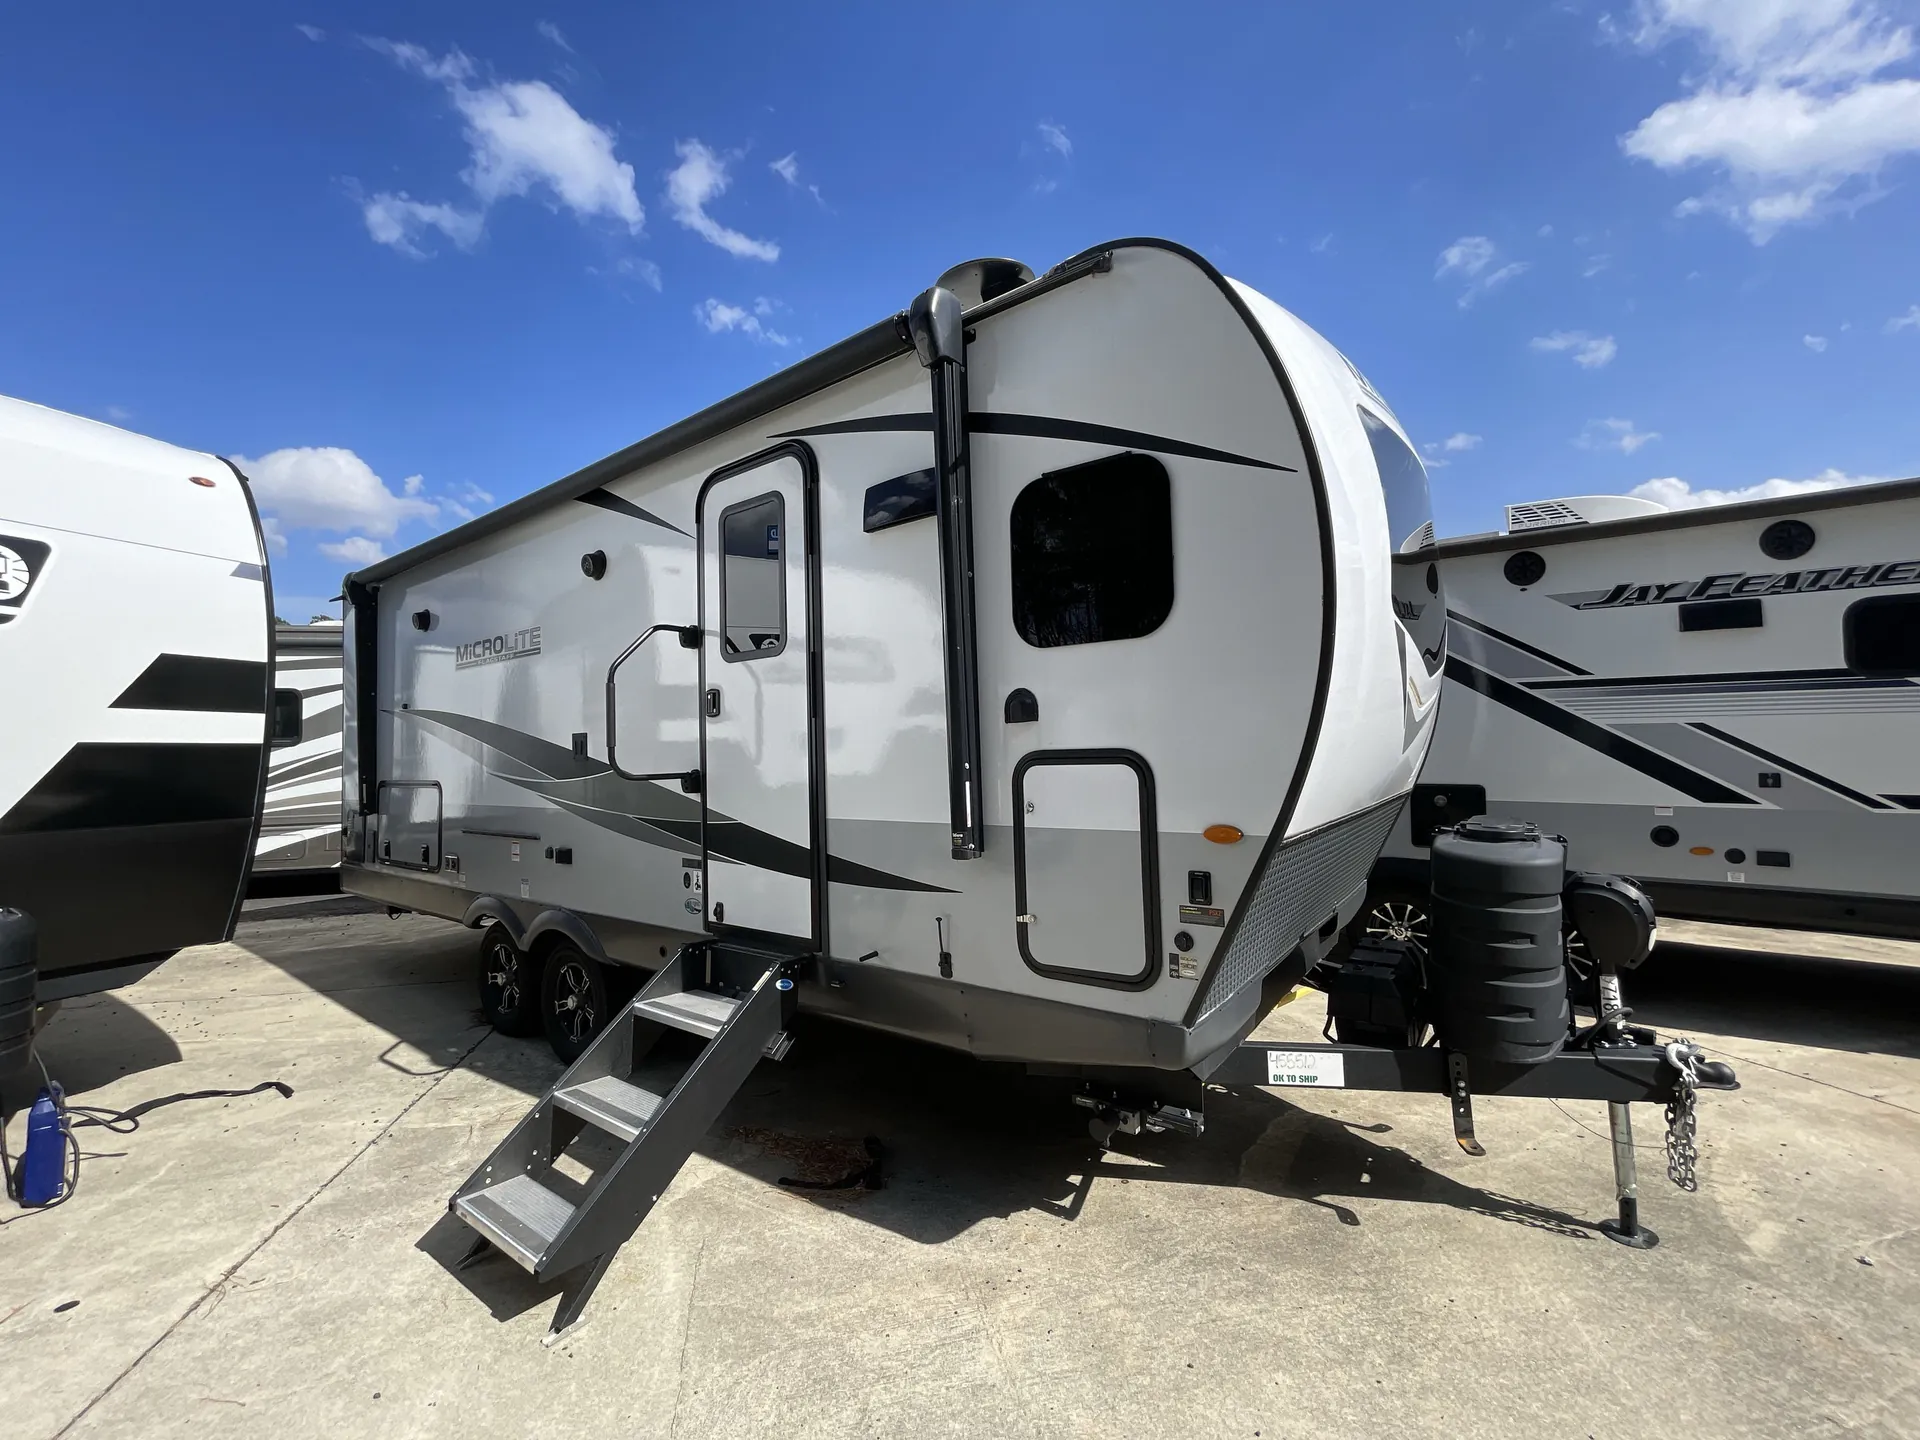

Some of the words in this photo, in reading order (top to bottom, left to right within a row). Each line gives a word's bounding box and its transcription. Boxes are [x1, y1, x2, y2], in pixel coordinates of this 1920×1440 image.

[1579, 582, 1683, 609] JAY
[1686, 560, 1920, 601] FEATHE
[477, 653, 515, 665] FLAGSTAFF
[1273, 1074, 1284, 1082] OK
[1286, 1074, 1296, 1083] TO
[1299, 1075, 1318, 1083] SHIP
